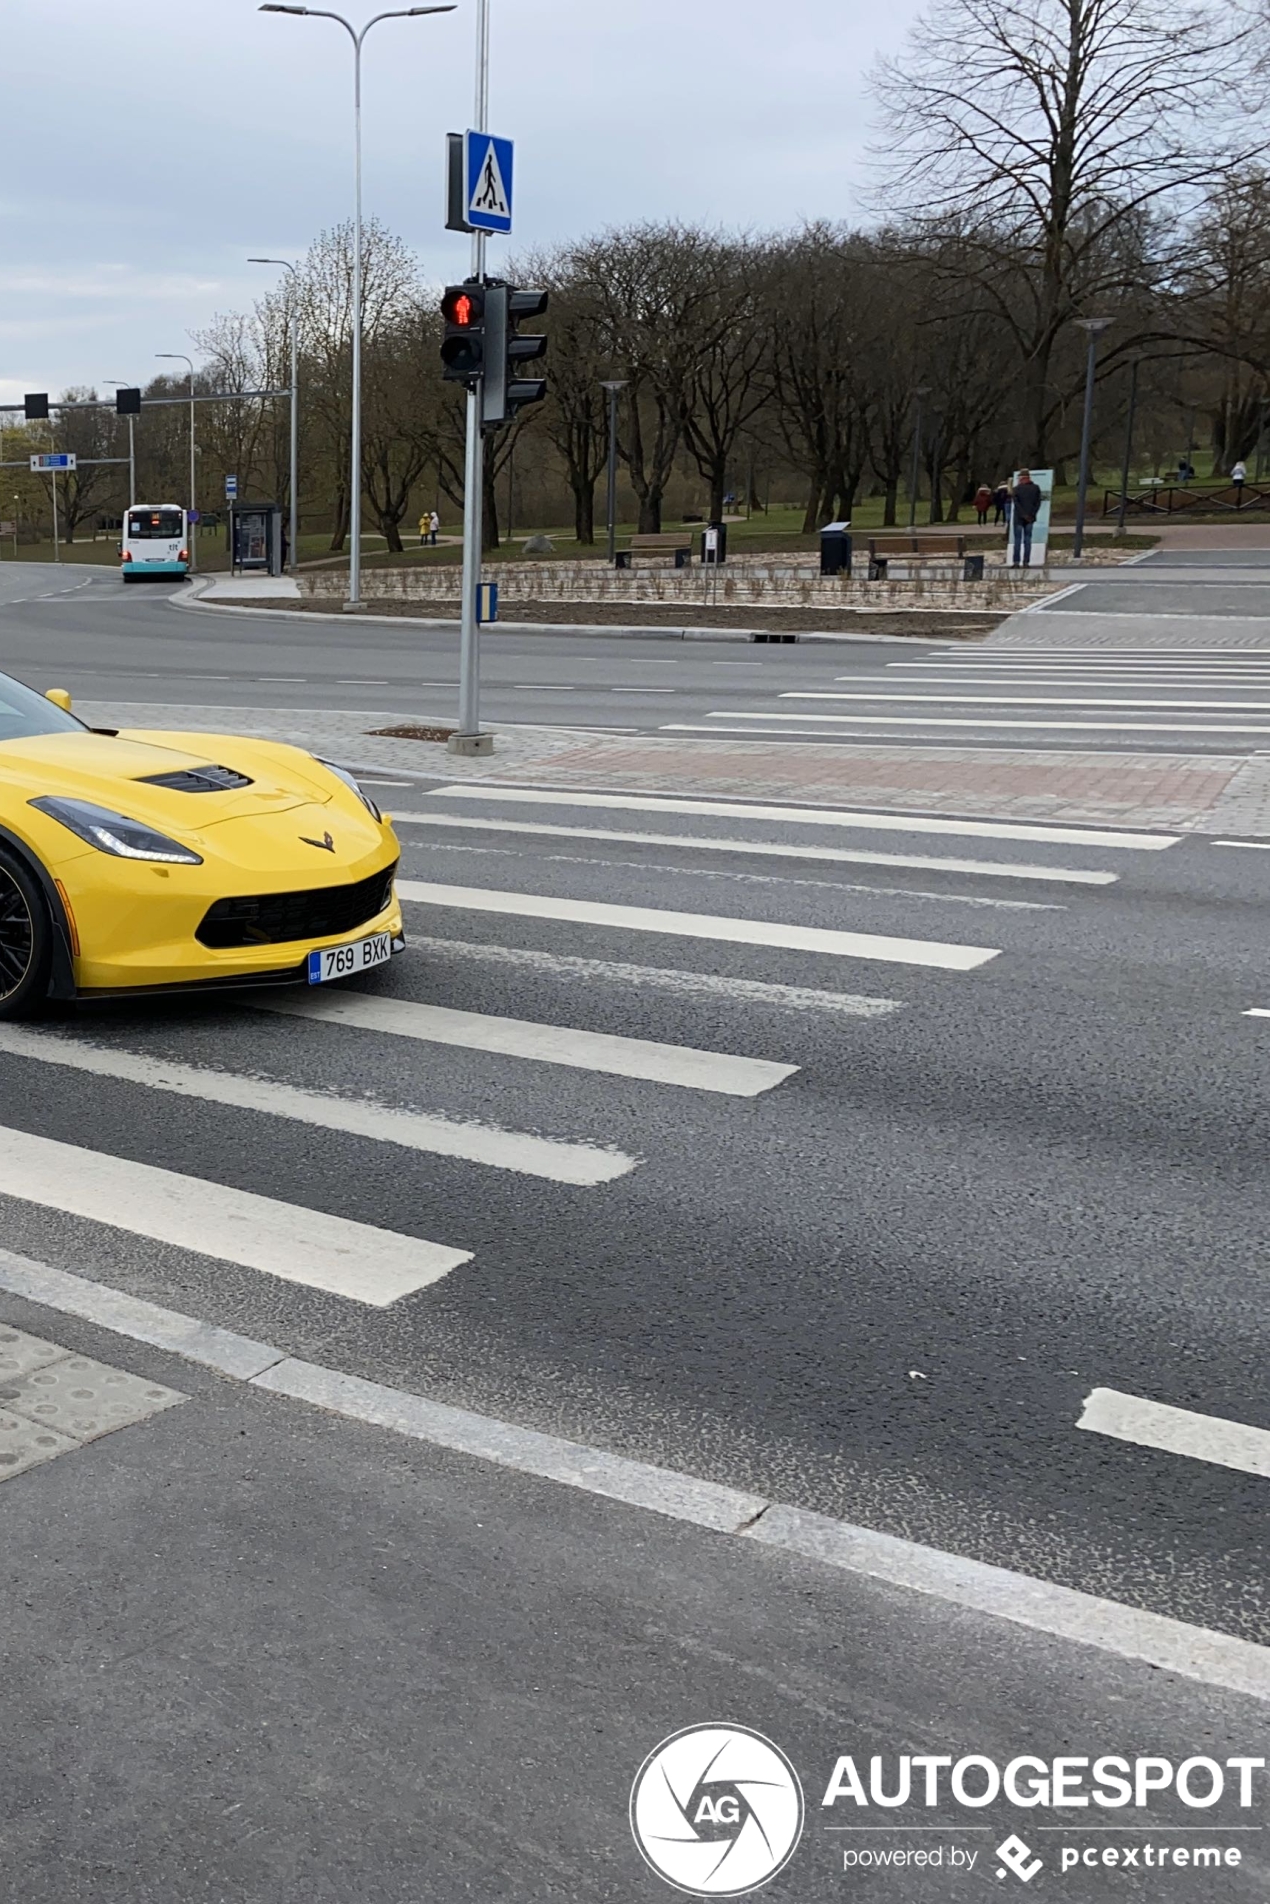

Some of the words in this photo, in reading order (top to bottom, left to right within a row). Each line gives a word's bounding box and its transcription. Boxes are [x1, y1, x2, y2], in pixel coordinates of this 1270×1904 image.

[326, 947, 355, 976] 769
[363, 935, 388, 965] BXK
[310, 972, 320, 980] EST
